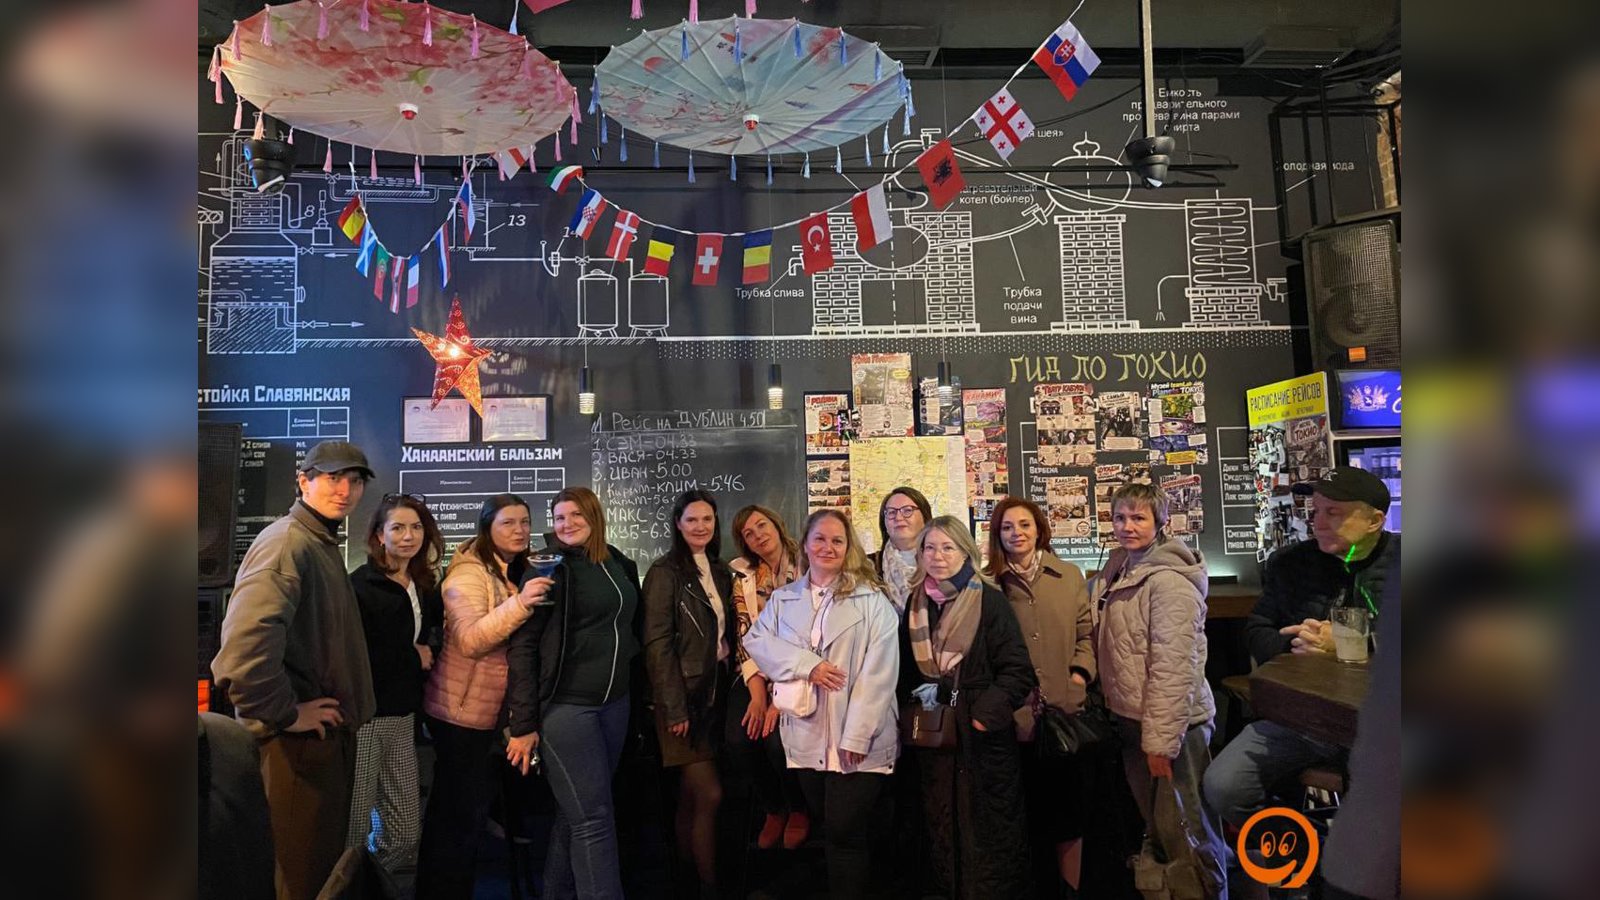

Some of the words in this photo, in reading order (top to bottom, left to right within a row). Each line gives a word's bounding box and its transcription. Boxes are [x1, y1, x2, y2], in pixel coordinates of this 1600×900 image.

[1131, 100, 1227, 111] првариельного
[1122, 112, 1170, 123] проева
[1201, 112, 1240, 121] парами
[1163, 123, 1200, 132] сирта
[1276, 162, 1327, 172] олодая
[960, 183, 1038, 195] агревательный
[960, 195, 988, 204] котел
[990, 194, 1035, 205] (бойлер)
[304, 204, 316, 218] 8
[507, 214, 527, 227] 13
[735, 287, 771, 300] Трубка
[1002, 286, 1042, 300] Трубка
[1003, 302, 1043, 312] подачи
[1010, 315, 1038, 324] вина
[1009, 353, 1061, 383] ГИД
[1071, 354, 1107, 381] ПО
[1112, 350, 1207, 382] ТОКИО
[1292, 381, 1322, 404] РЕЙСОВ
[401, 446, 495, 463] Ханаанский
[499, 448, 563, 461] бальзам
